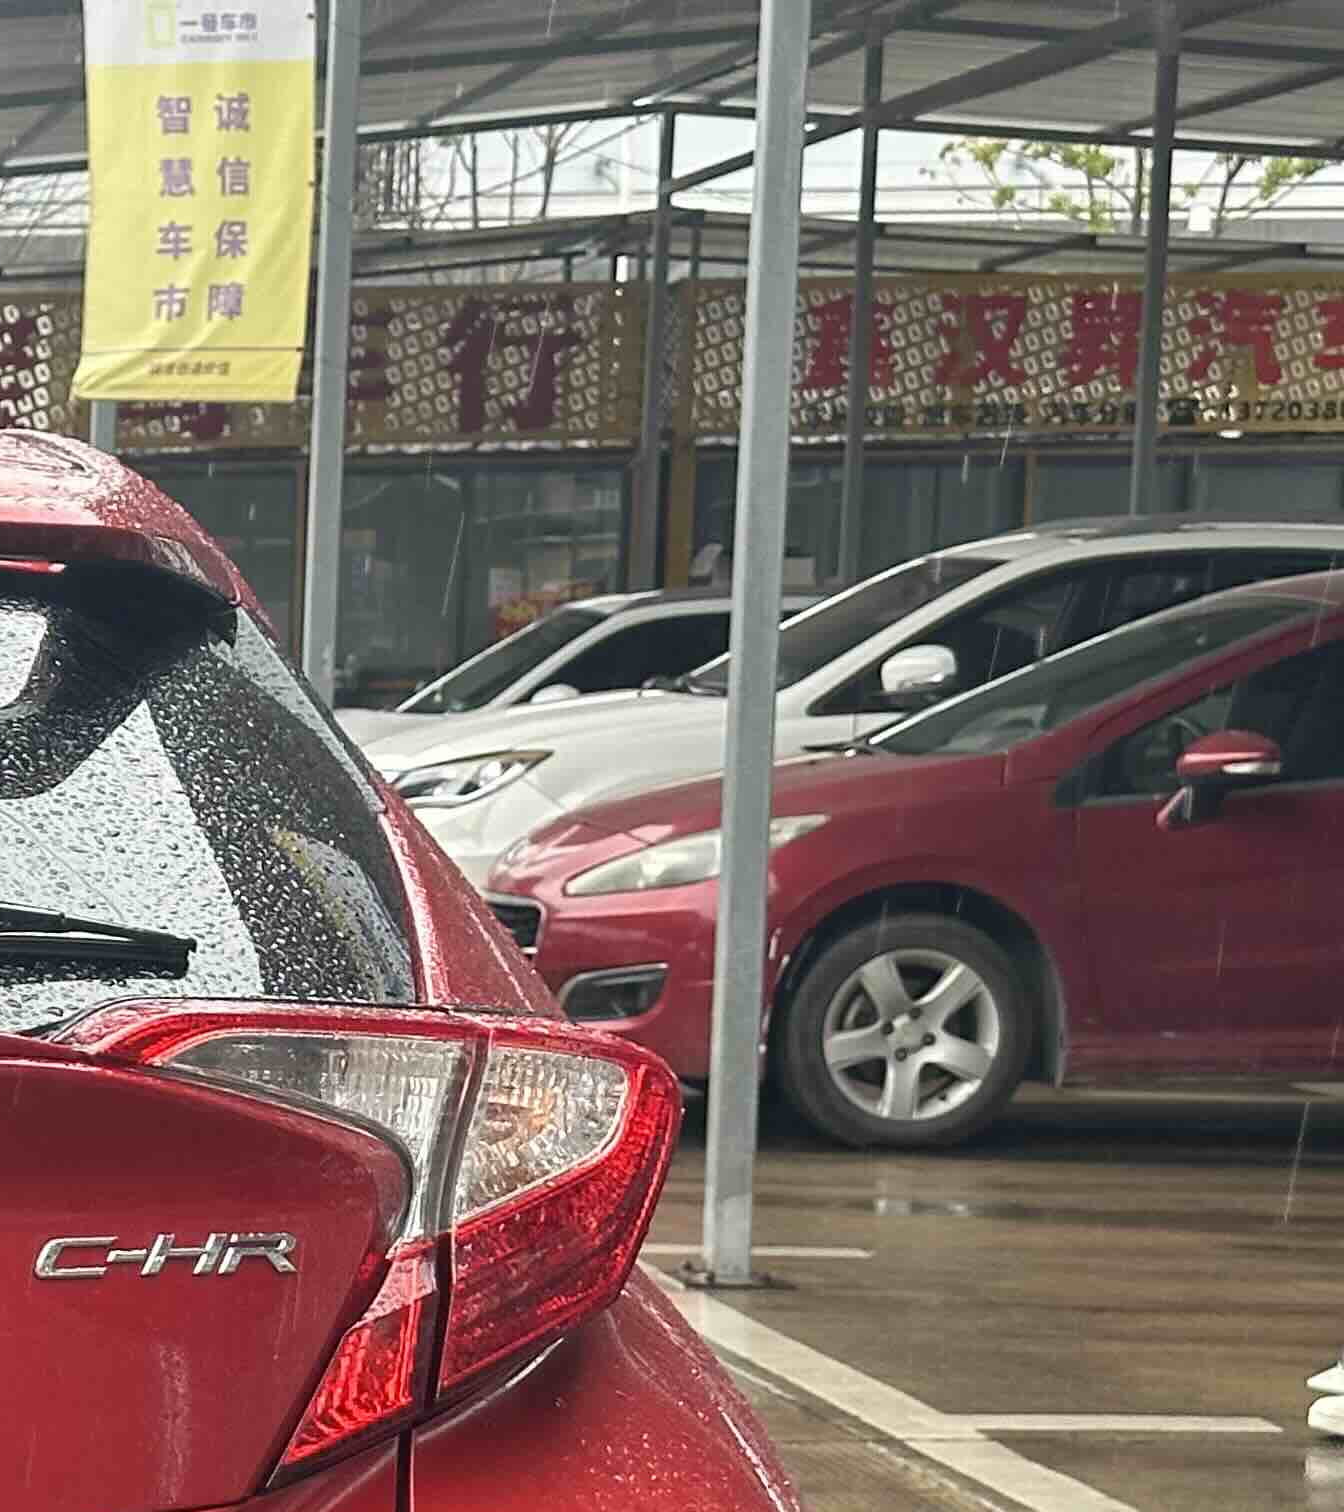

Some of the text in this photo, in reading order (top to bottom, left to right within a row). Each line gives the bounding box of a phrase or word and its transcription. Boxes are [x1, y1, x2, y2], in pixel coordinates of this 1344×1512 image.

[154, 96, 196, 322] 智慧车市
[207, 93, 252, 321] 诚信保障
[33, 1232, 297, 1280] C-HR
